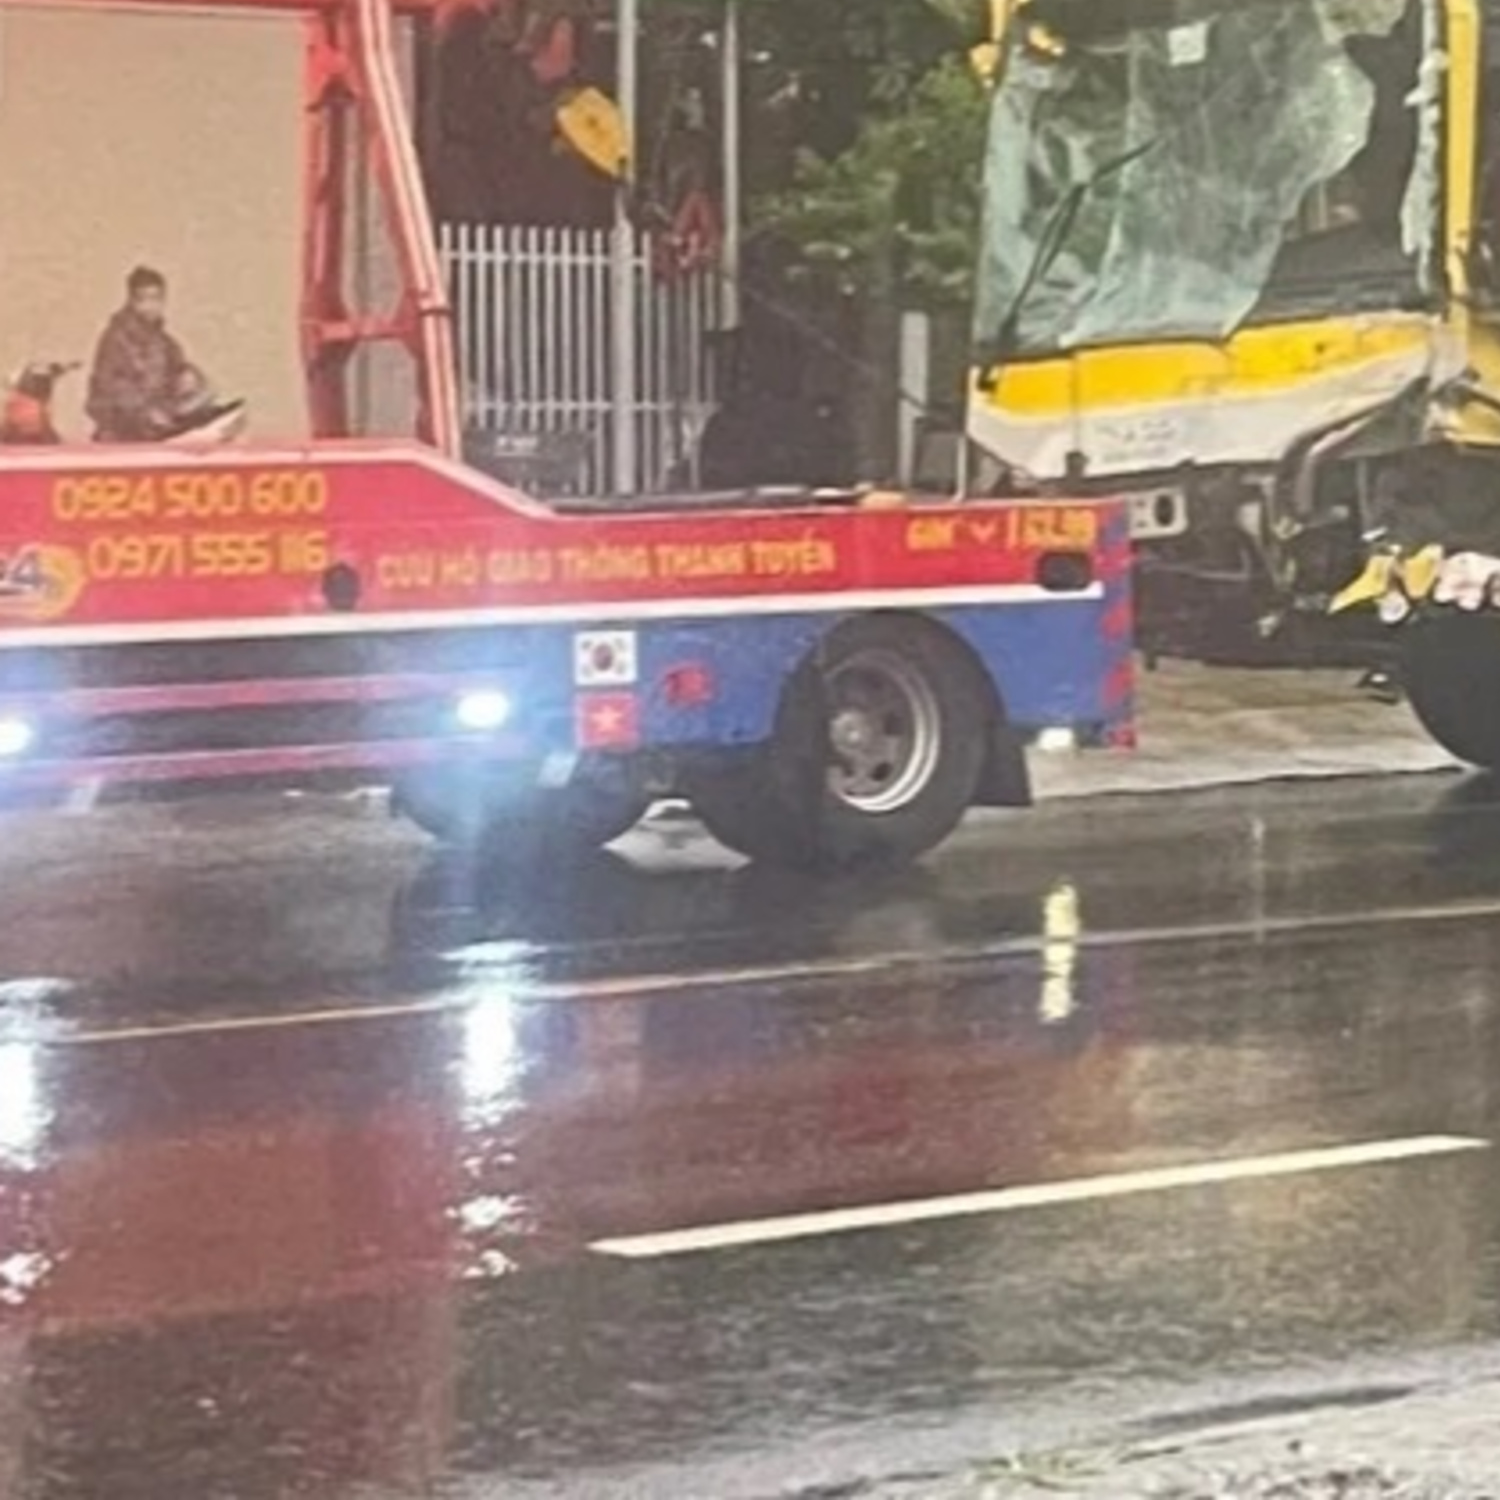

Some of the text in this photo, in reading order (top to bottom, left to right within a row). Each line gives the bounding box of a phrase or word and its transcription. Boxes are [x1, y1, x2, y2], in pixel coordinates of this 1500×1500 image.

[54, 470, 327, 521] 0924 500 600
[88, 536, 184, 579] 0971
[191, 534, 275, 576] 555
